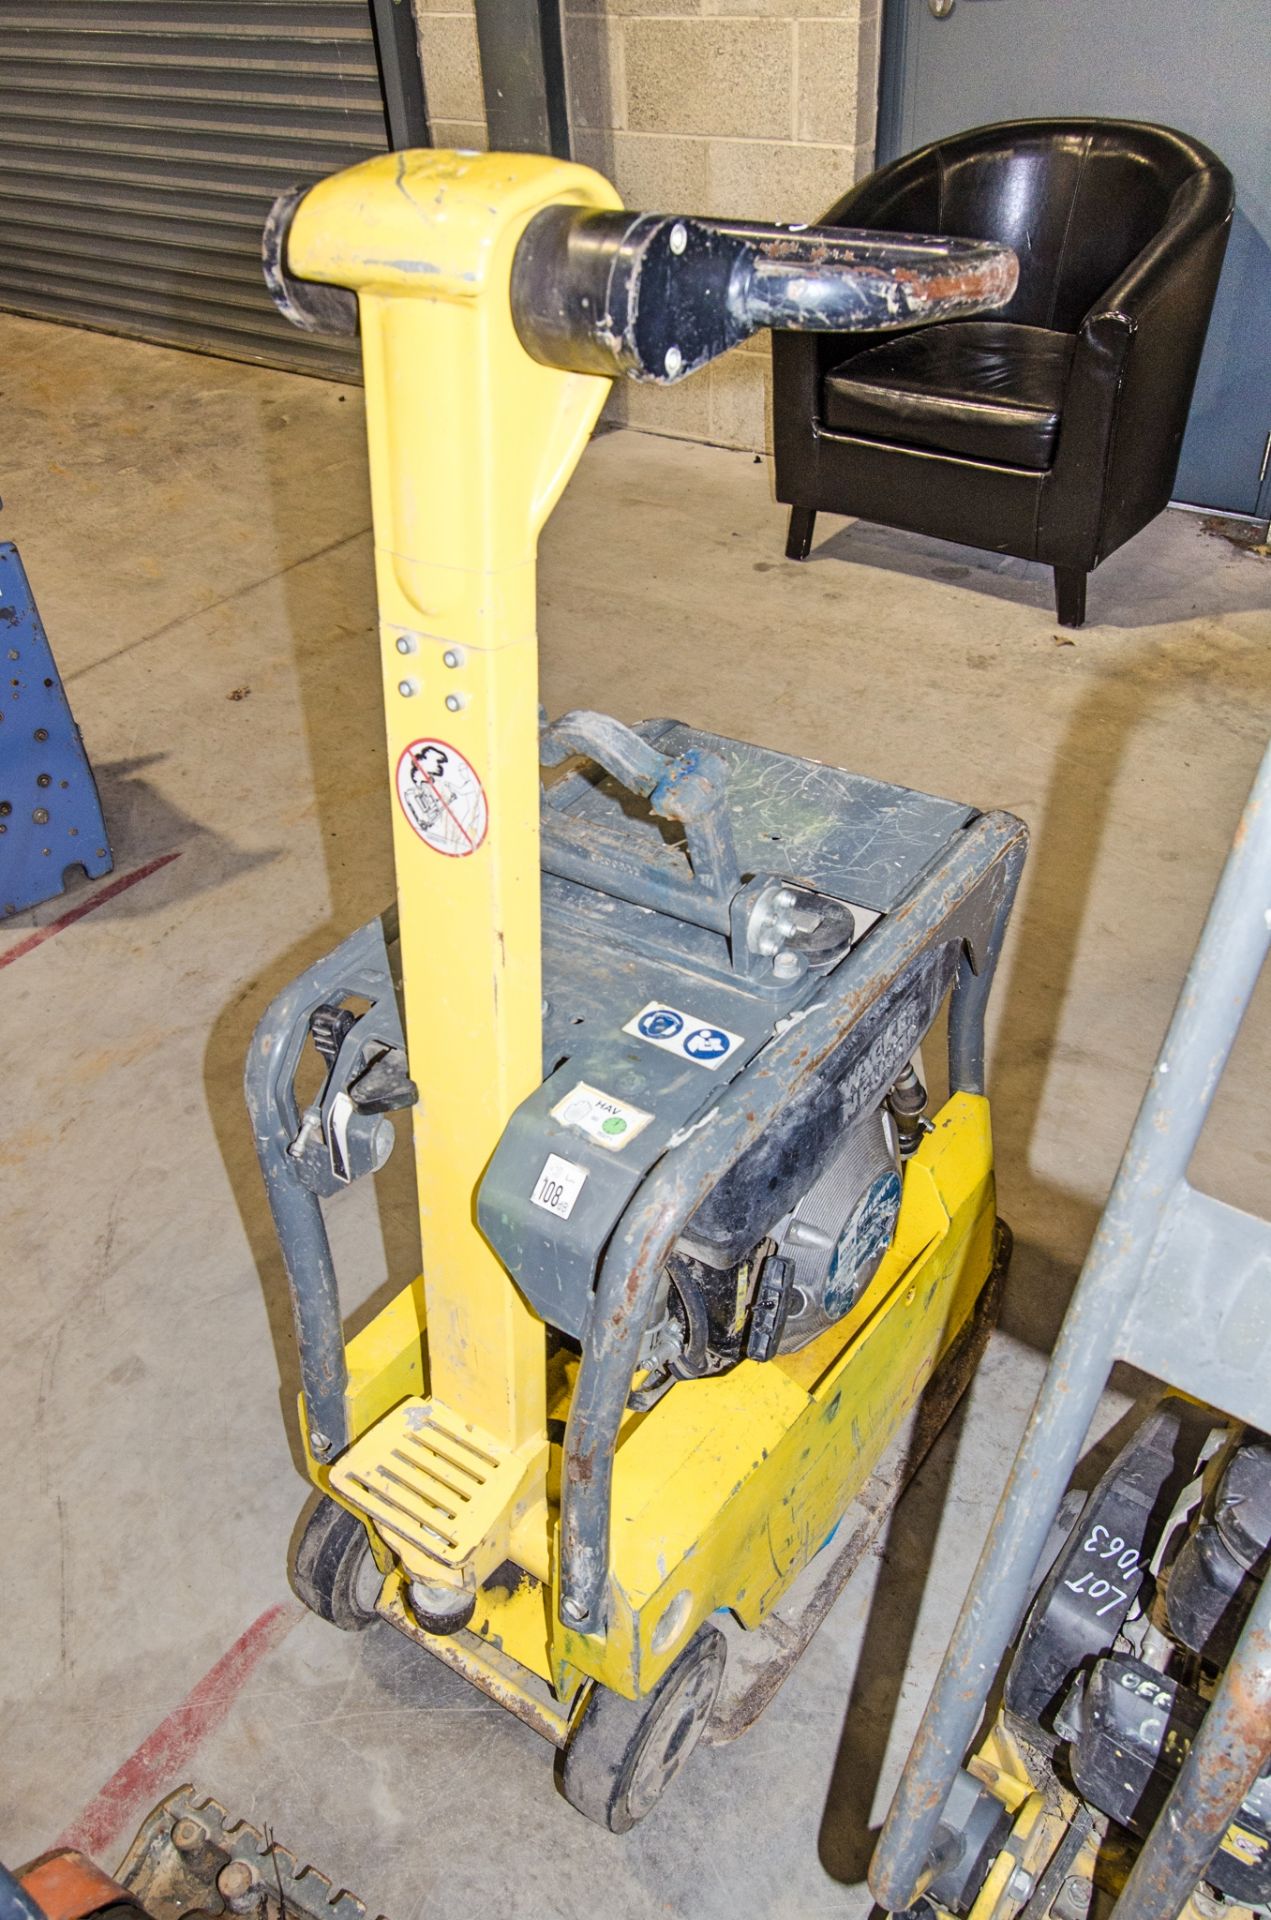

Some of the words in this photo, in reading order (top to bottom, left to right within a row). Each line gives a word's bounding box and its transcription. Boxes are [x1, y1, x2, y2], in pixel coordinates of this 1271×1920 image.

[595, 1101, 621, 1115] HAV
[538, 1176, 563, 1207] 108
[1084, 1525, 1142, 1580] 1063
[1064, 1571, 1127, 1616] LOT
